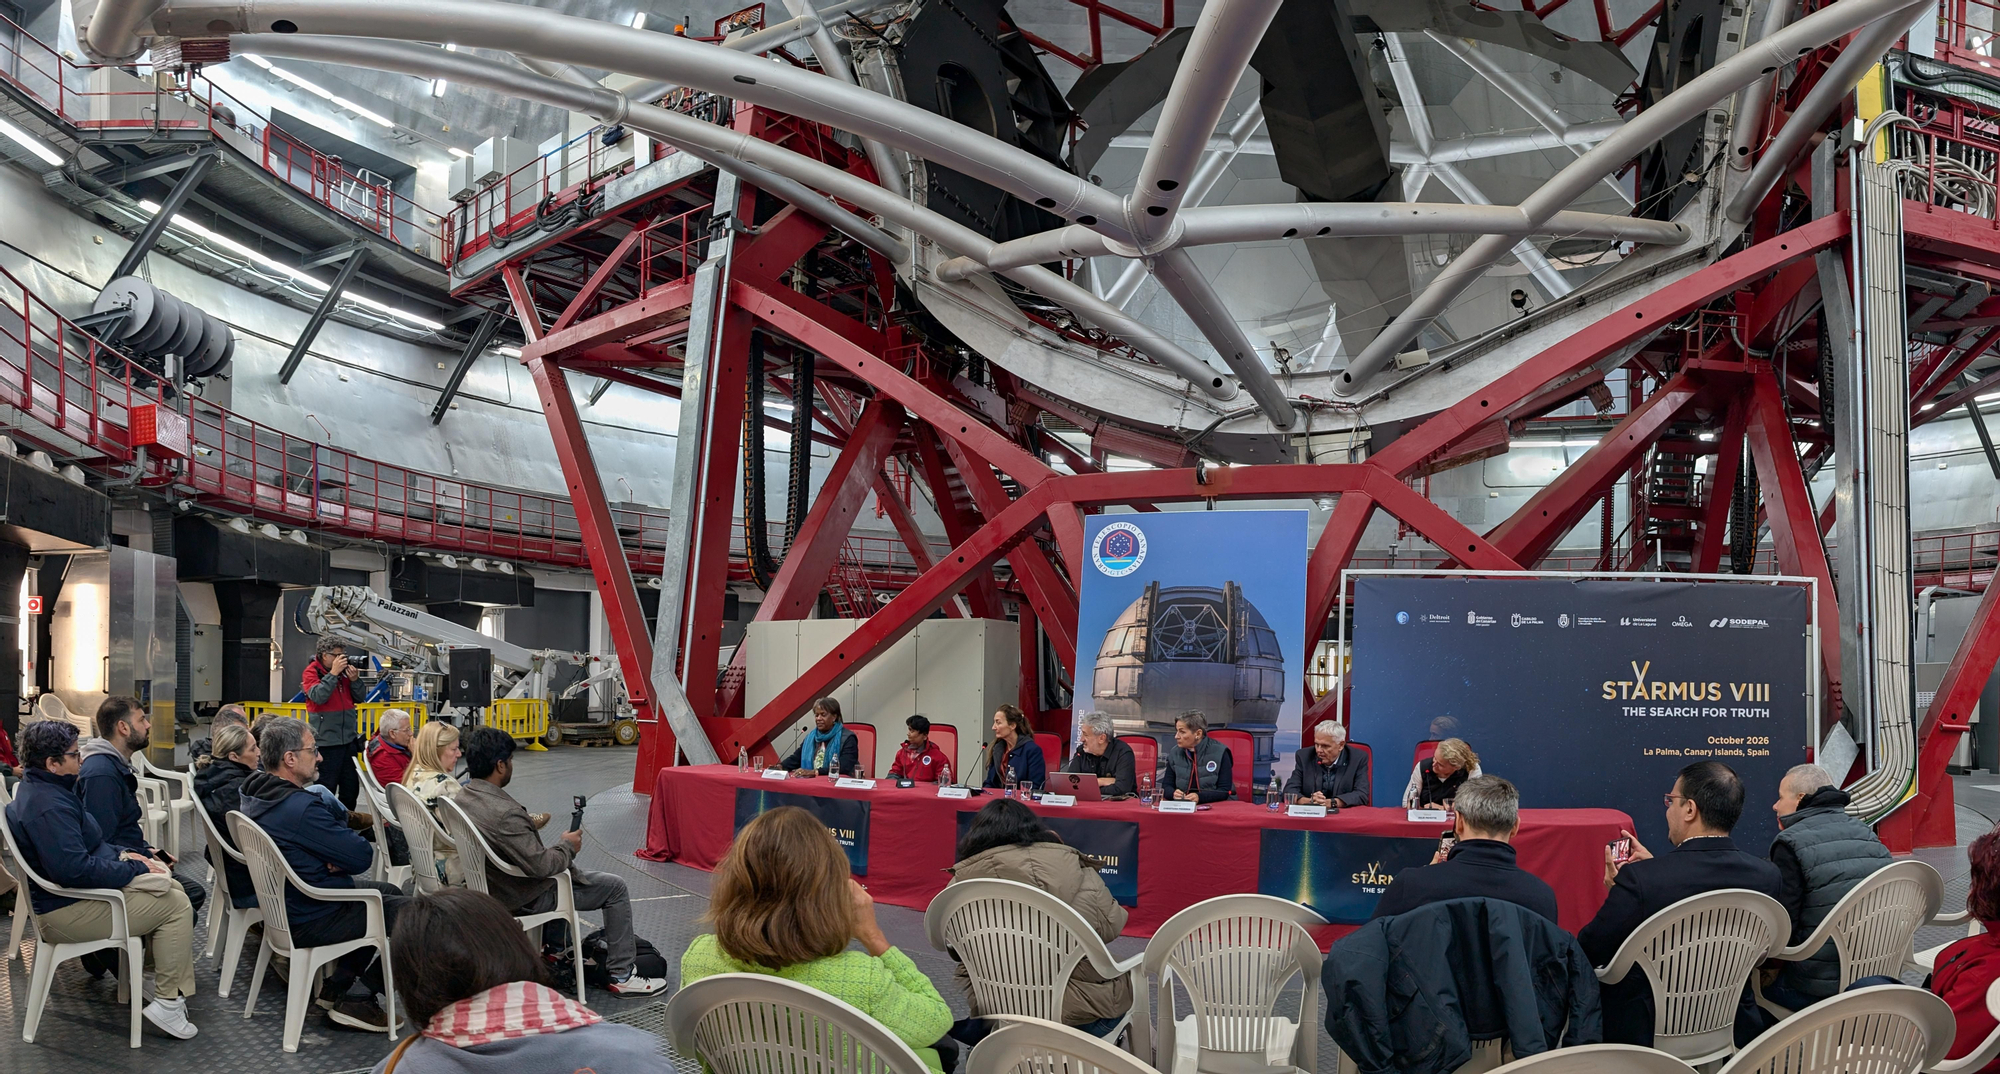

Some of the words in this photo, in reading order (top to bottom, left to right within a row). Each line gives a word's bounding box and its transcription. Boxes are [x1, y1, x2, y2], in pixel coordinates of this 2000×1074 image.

[1093, 523, 1137, 549] TELESCOPIO
[1128, 532, 1146, 571] CANARIAS
[377, 599, 419, 619] Palazzani
[1729, 618, 1769, 626] SODEPAL
[1602, 660, 1722, 702] STARMUS
[1729, 683, 1770, 702] VIII
[1622, 707, 1646, 717] THE
[1649, 707, 1699, 717] SEARCH
[1702, 707, 1727, 718] FOR
[1730, 708, 1770, 718] TRUTH
[1707, 736, 1745, 745] October
[1746, 736, 1769, 745] 2026
[1643, 748, 1653, 756] La
[1655, 748, 1682, 757] Palma,
[1684, 748, 1713, 757] Canary
[1715, 748, 1745, 757] Islands,
[1747, 748, 1770, 757] Spain
[839, 828, 855, 839] VIII
